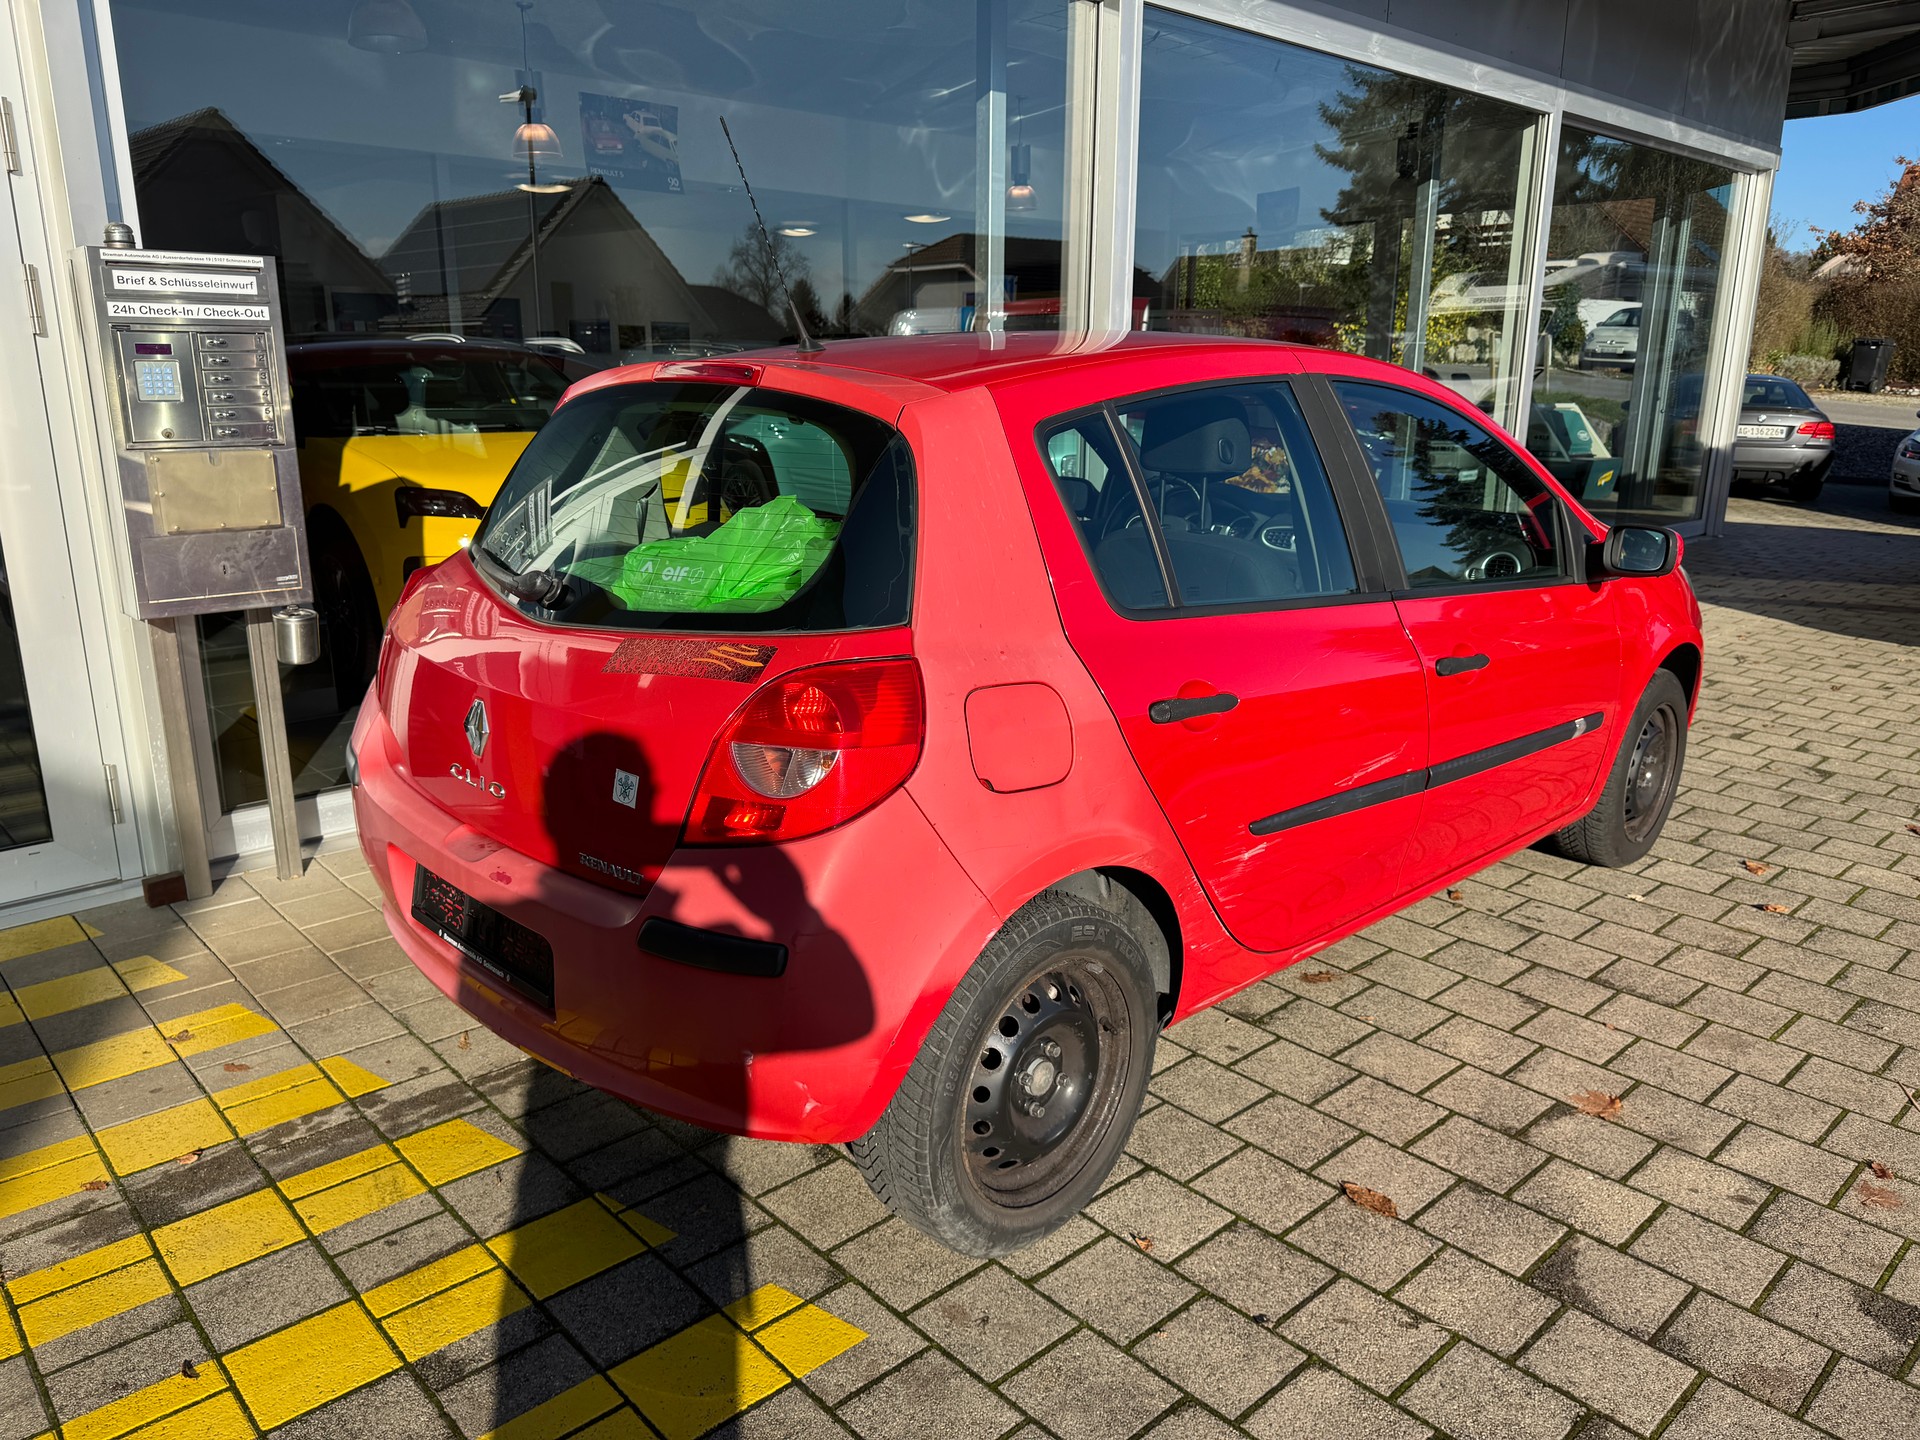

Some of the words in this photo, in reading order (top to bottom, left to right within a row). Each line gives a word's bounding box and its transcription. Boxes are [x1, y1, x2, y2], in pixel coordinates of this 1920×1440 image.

[117, 275, 145, 286] Brief
[148, 277, 157, 286] &
[160, 276, 254, 290] Schlüsseleinwurf
[112, 304, 136, 315] 24h
[139, 305, 194, 316] Check-In
[203, 307, 265, 318] Check-Out
[258, 354, 265, 362] 2
[260, 372, 267, 380] 3
[262, 390, 269, 398] 4
[265, 407, 271, 415] 5
[662, 566, 690, 582] elf
[449, 763, 506, 799] CLIO
[578, 852, 644, 886] RENAULT
[943, 1045, 968, 1097] 185/60
[965, 1012, 983, 1041] R15
